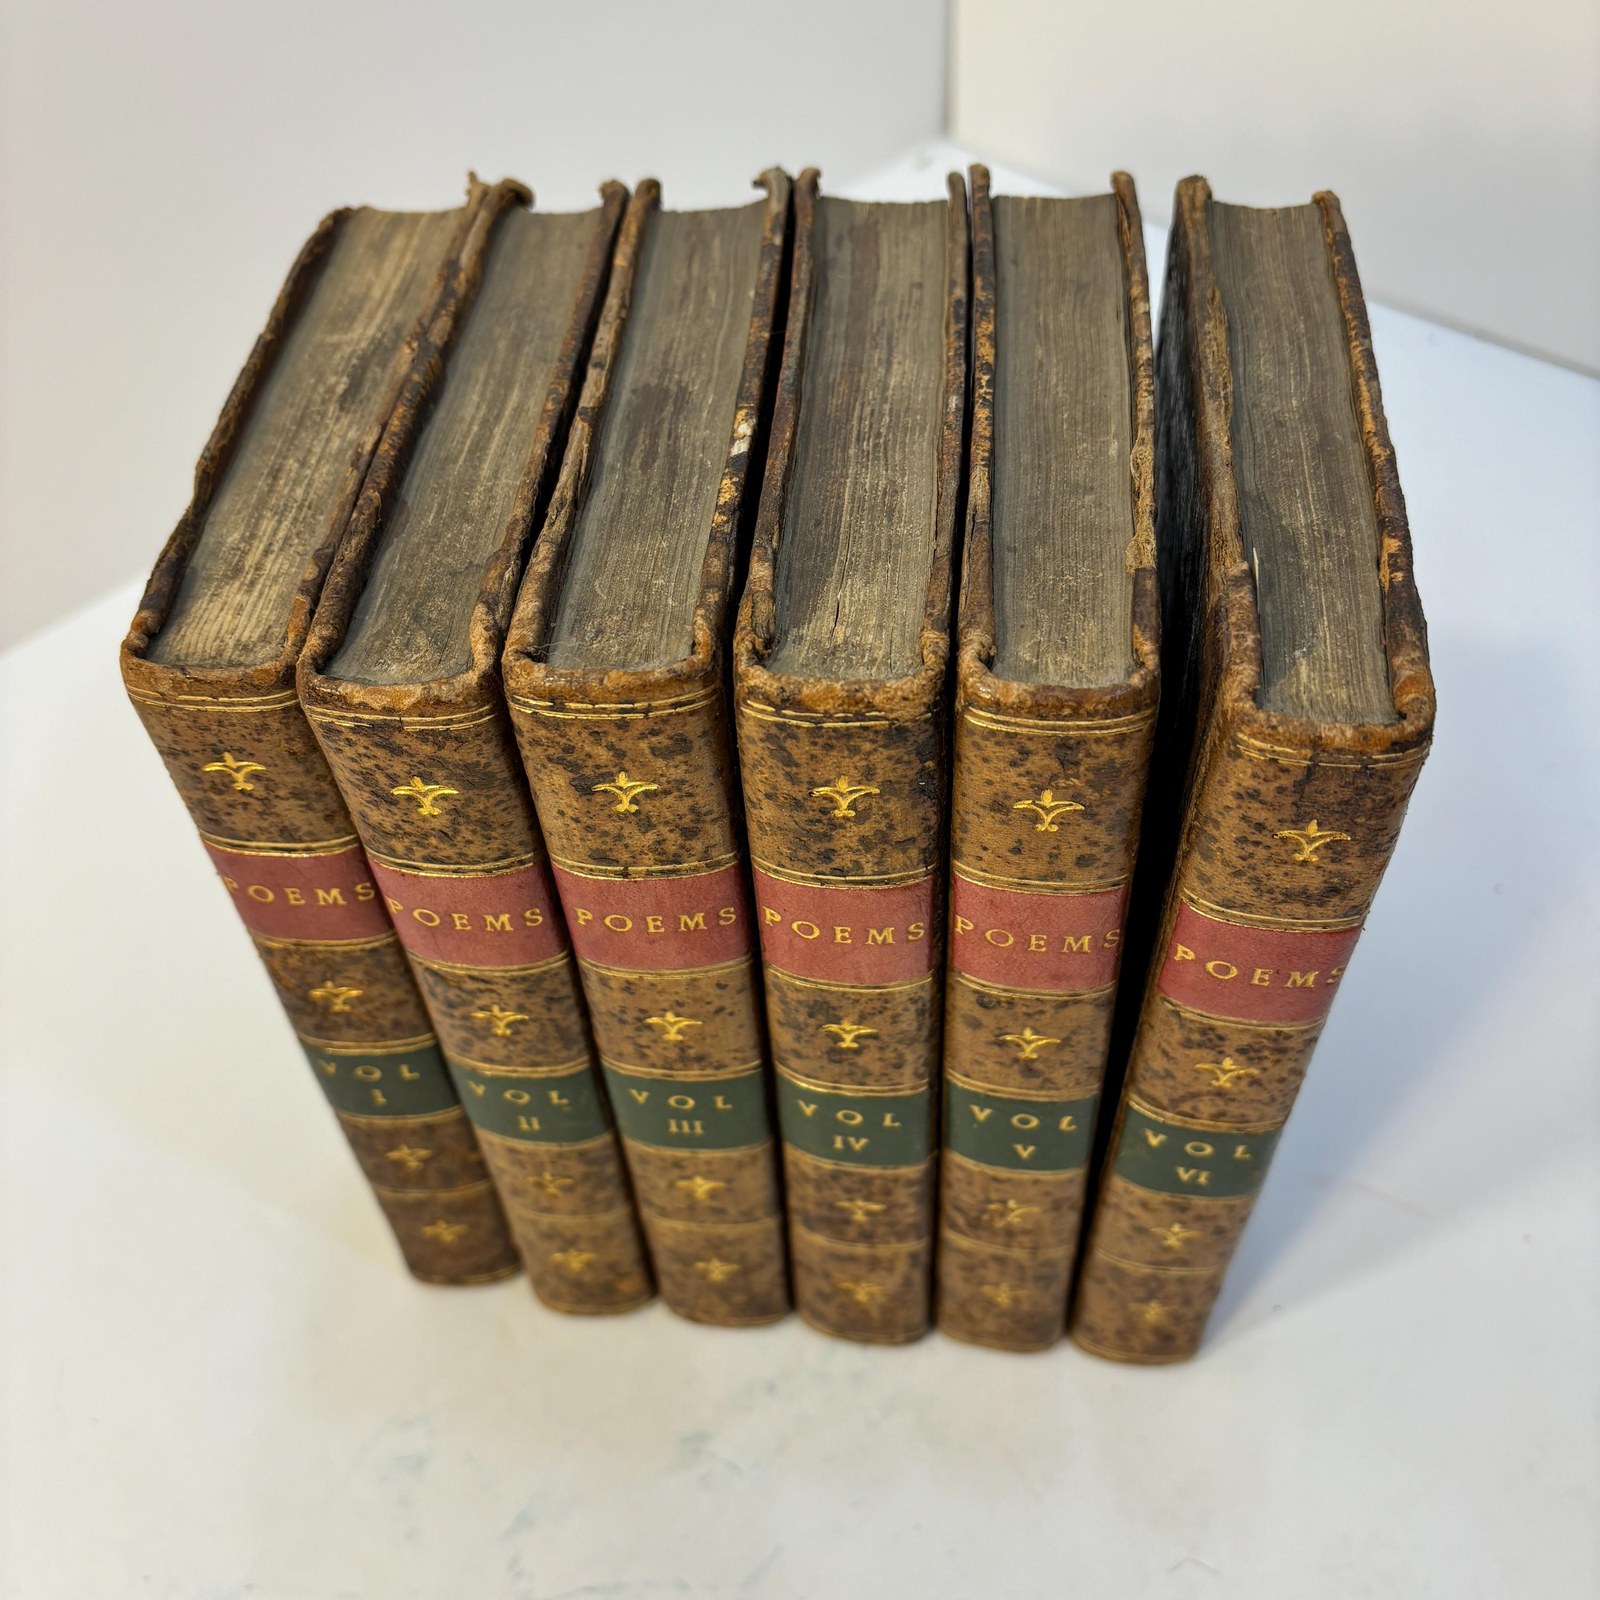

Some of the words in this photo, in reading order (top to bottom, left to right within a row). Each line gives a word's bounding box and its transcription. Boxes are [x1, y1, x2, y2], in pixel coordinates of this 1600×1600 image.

[386, 897, 544, 932] POEMS
[573, 906, 737, 932] POEMS
[763, 906, 926, 945] POEMS
[955, 916, 1120, 954] POEMS
[317, 1059, 421, 1082] VOL
[467, 1080, 570, 1106] VOL
[629, 1088, 733, 1110] VOL
[518, 1115, 541, 1131] II
[797, 1099, 900, 1127] VOL
[970, 1104, 1077, 1131] VOL
[668, 1119, 704, 1134] III
[833, 1135, 869, 1151] IV
[1013, 1143, 1036, 1160] V
[1144, 1128, 1252, 1160] VOL
[1177, 1166, 1211, 1186] VI
